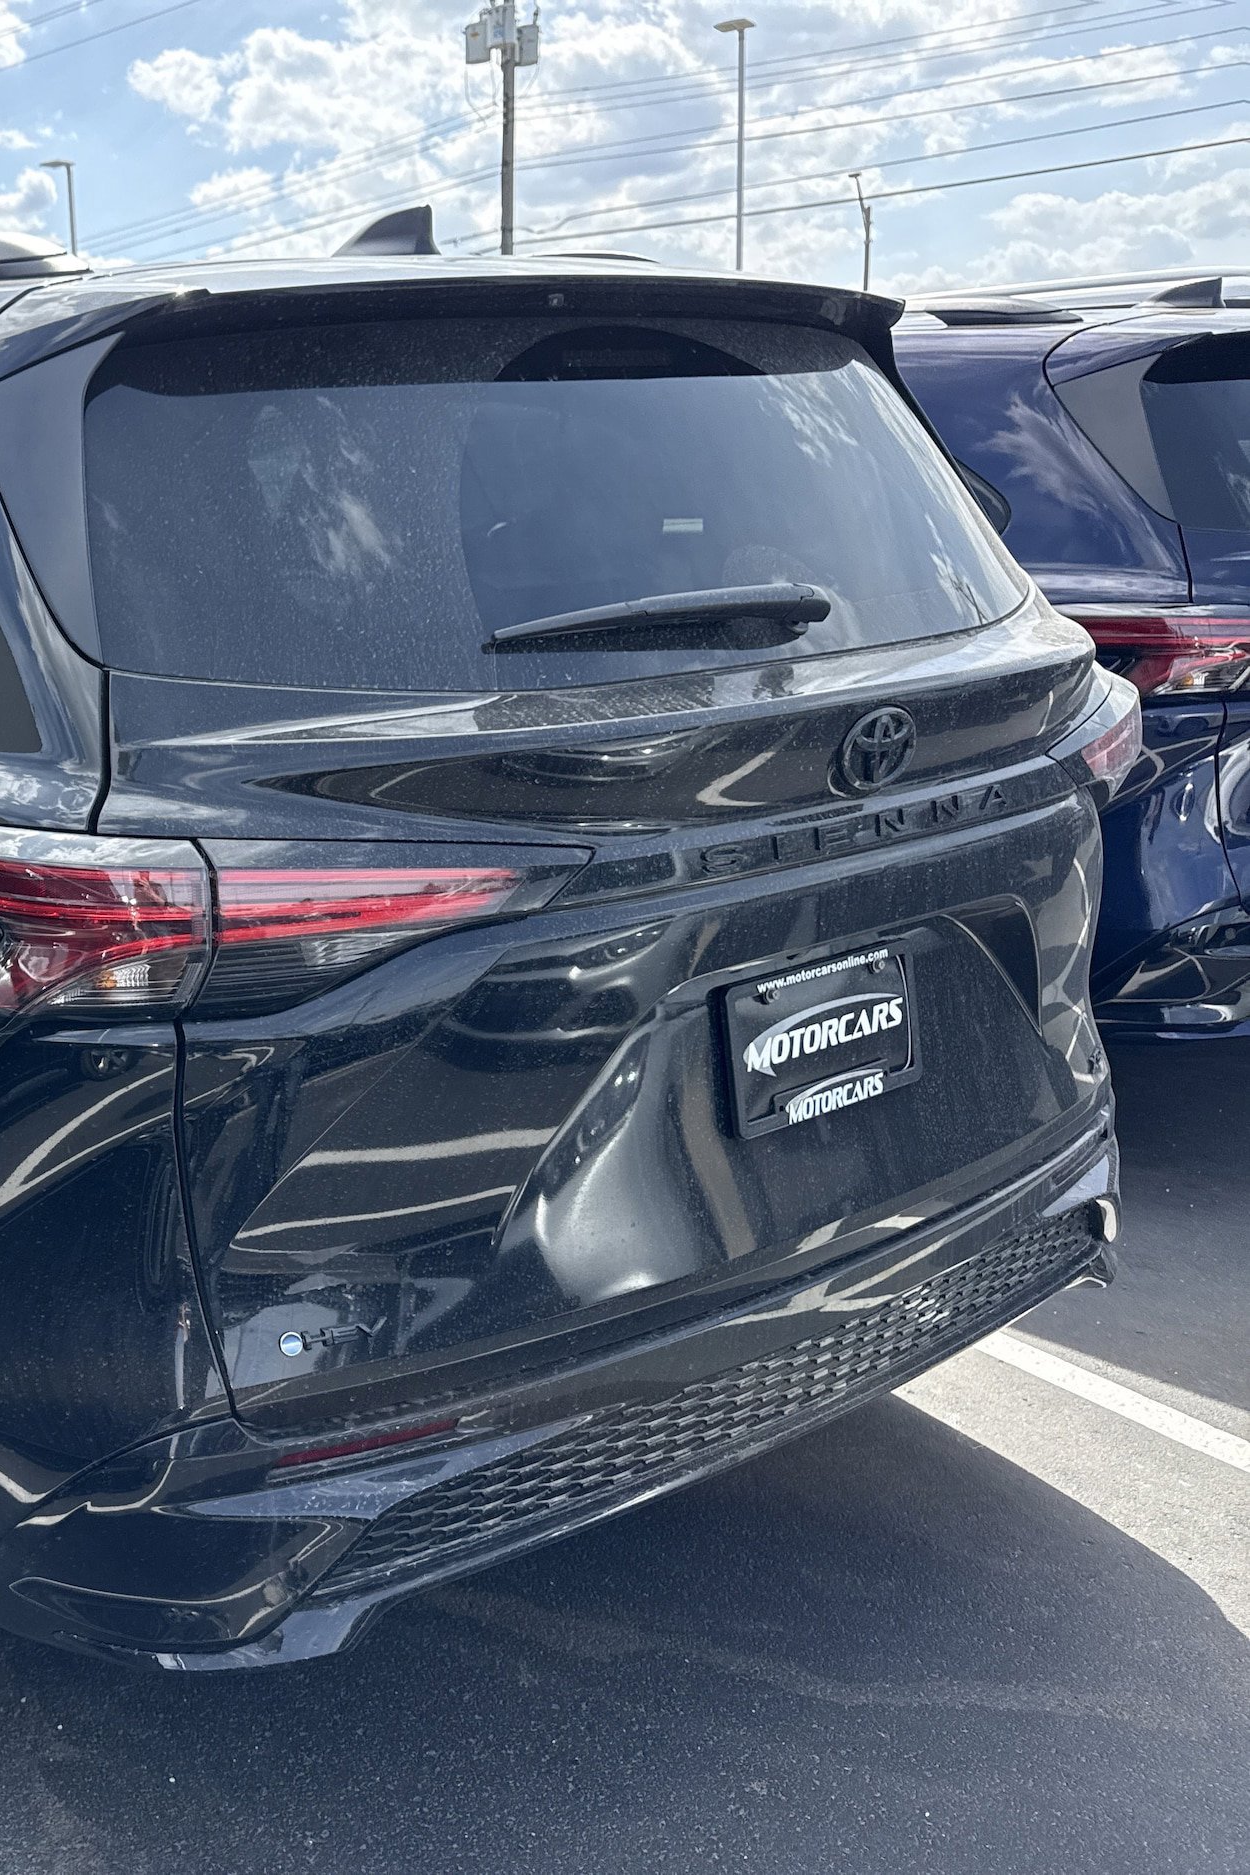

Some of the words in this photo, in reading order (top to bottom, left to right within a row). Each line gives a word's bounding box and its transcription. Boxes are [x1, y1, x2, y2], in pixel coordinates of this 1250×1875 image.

[700, 785, 1008, 875] SIENNA
[757, 948, 888, 993] www.motorcarsonline.com
[747, 997, 903, 1073] MOTORCARS
[788, 1072, 884, 1125] MOTORCARS
